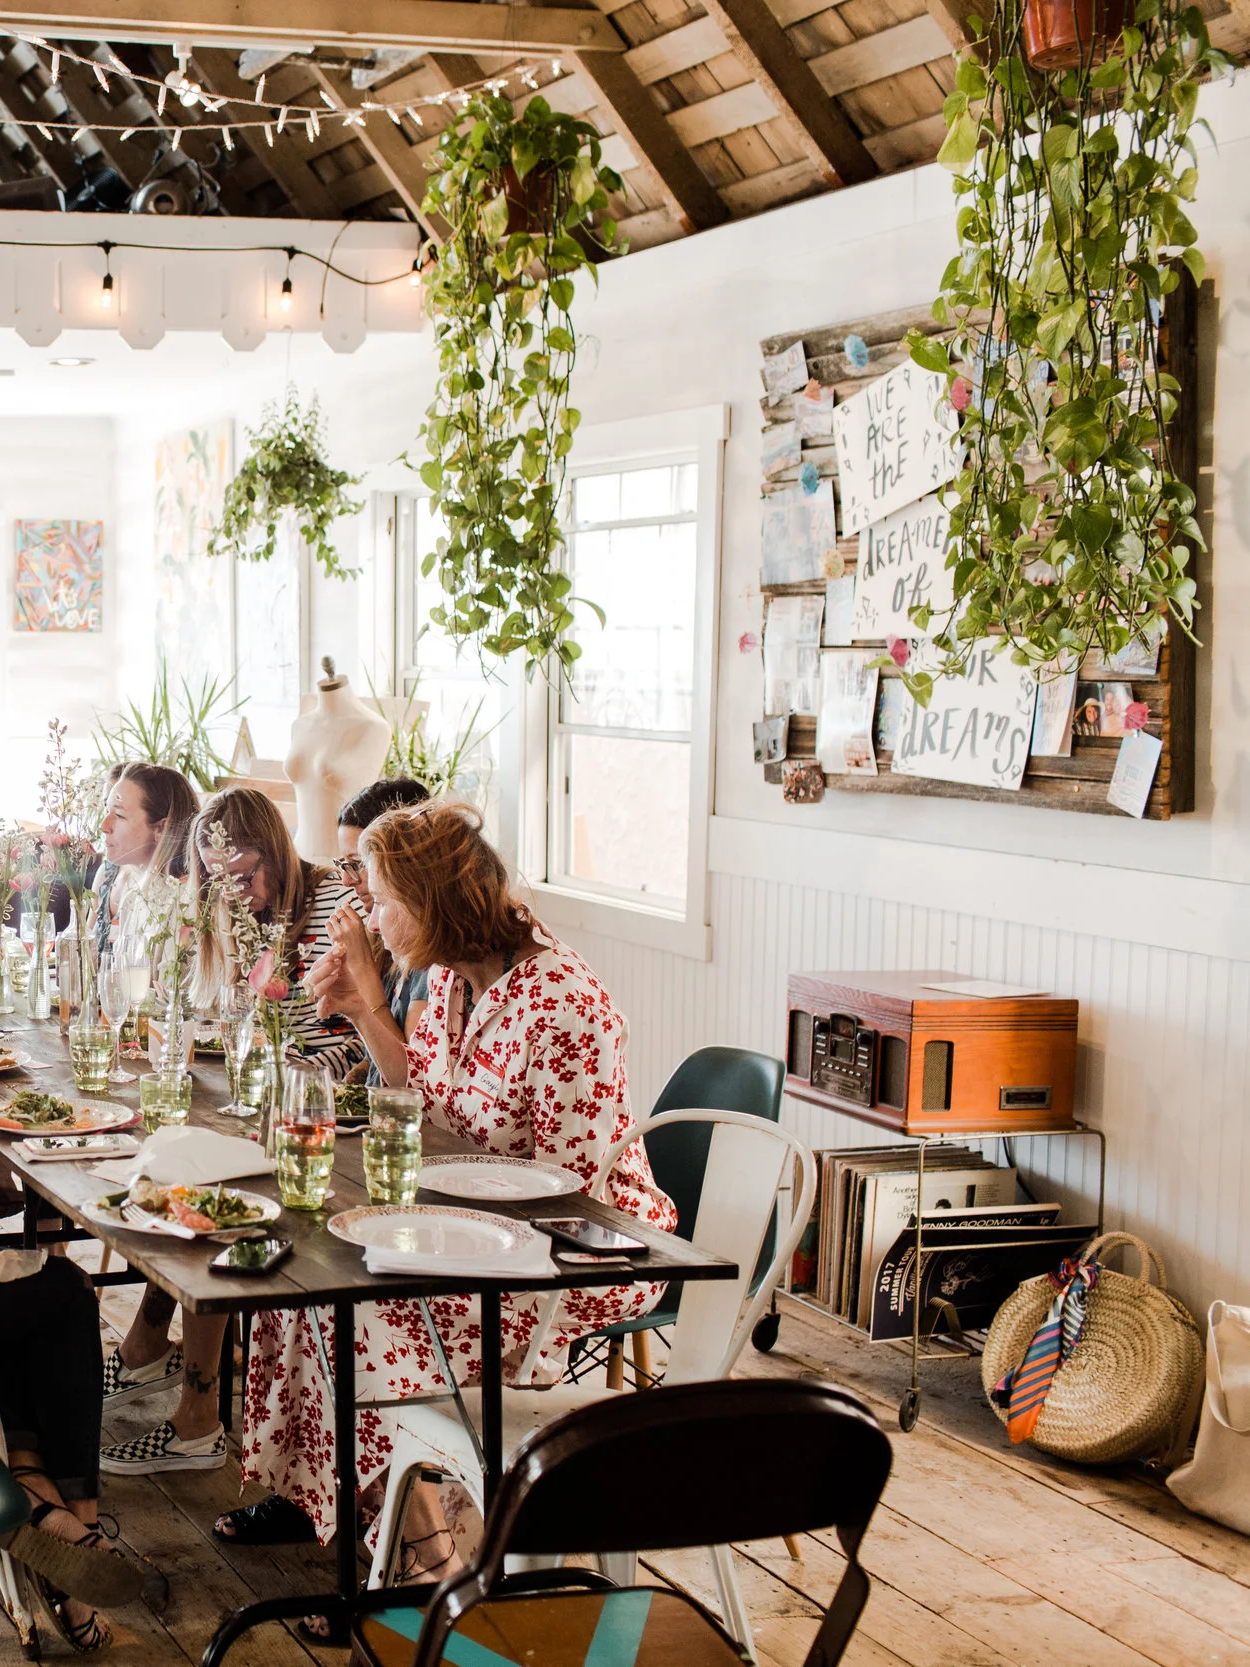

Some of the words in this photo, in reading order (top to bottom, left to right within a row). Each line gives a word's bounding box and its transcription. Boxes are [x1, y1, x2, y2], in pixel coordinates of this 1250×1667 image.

[866, 376, 895, 421] WE
[866, 406, 907, 460] ARE
[958, 1218, 1023, 1228] GOODMAN
[879, 1262, 896, 1293] 2017
[890, 1267, 905, 1311] SUMMER
